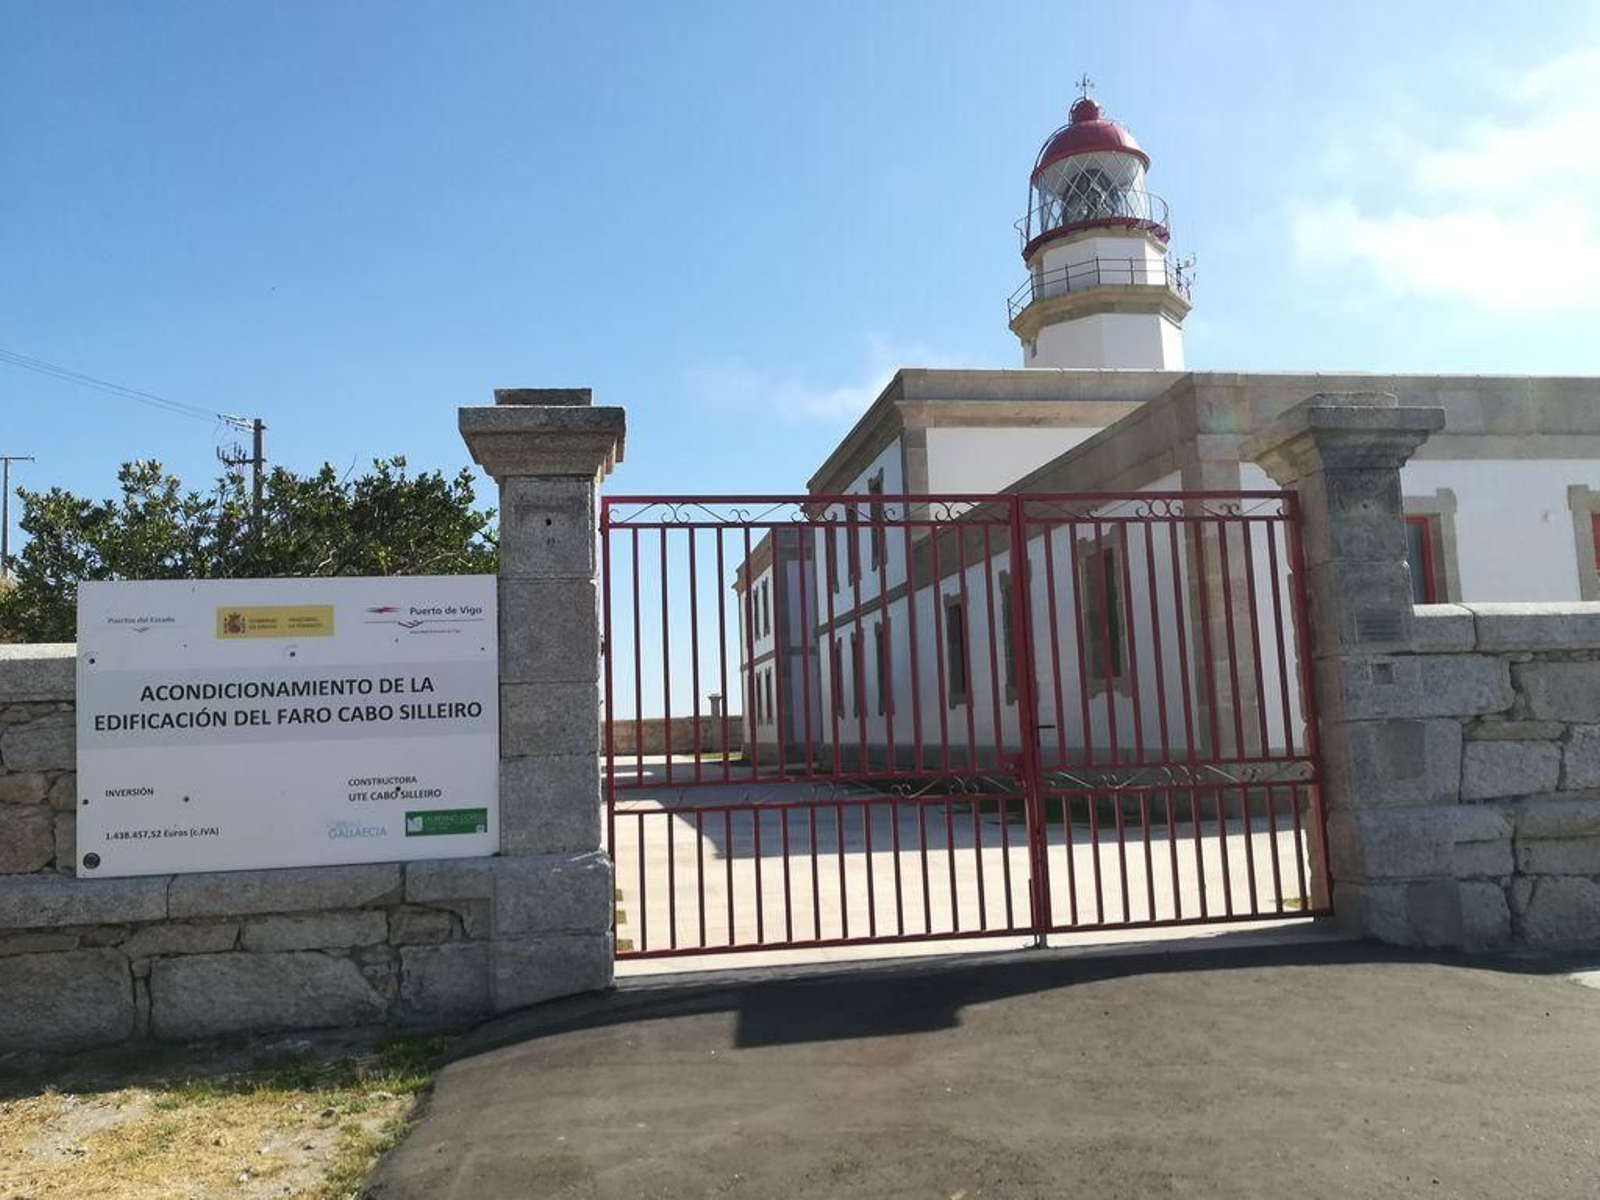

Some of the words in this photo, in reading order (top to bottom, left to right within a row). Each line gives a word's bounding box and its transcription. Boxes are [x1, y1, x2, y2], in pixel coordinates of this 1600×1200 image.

[409, 606, 442, 616] Puerto
[444, 605, 457, 615] de
[460, 605, 482, 616] Vigo
[139, 678, 373, 702] ACONDICIONAMIENTO
[379, 677, 404, 694] DE
[410, 677, 434, 693] LA
[94, 707, 227, 731] EDIFICACIÓN
[234, 709, 271, 726] DEL
[277, 707, 332, 725] FARO
[338, 705, 393, 723] CABO
[399, 702, 482, 720] SILLEIRO
[348, 776, 417, 787] CONSTRUCTORA
[105, 787, 154, 798] INVERSIÓN
[348, 792, 367, 802] UTE
[370, 790, 398, 801] CABO
[401, 788, 442, 799] SILLEIRO
[163, 828, 188, 839] Euros
